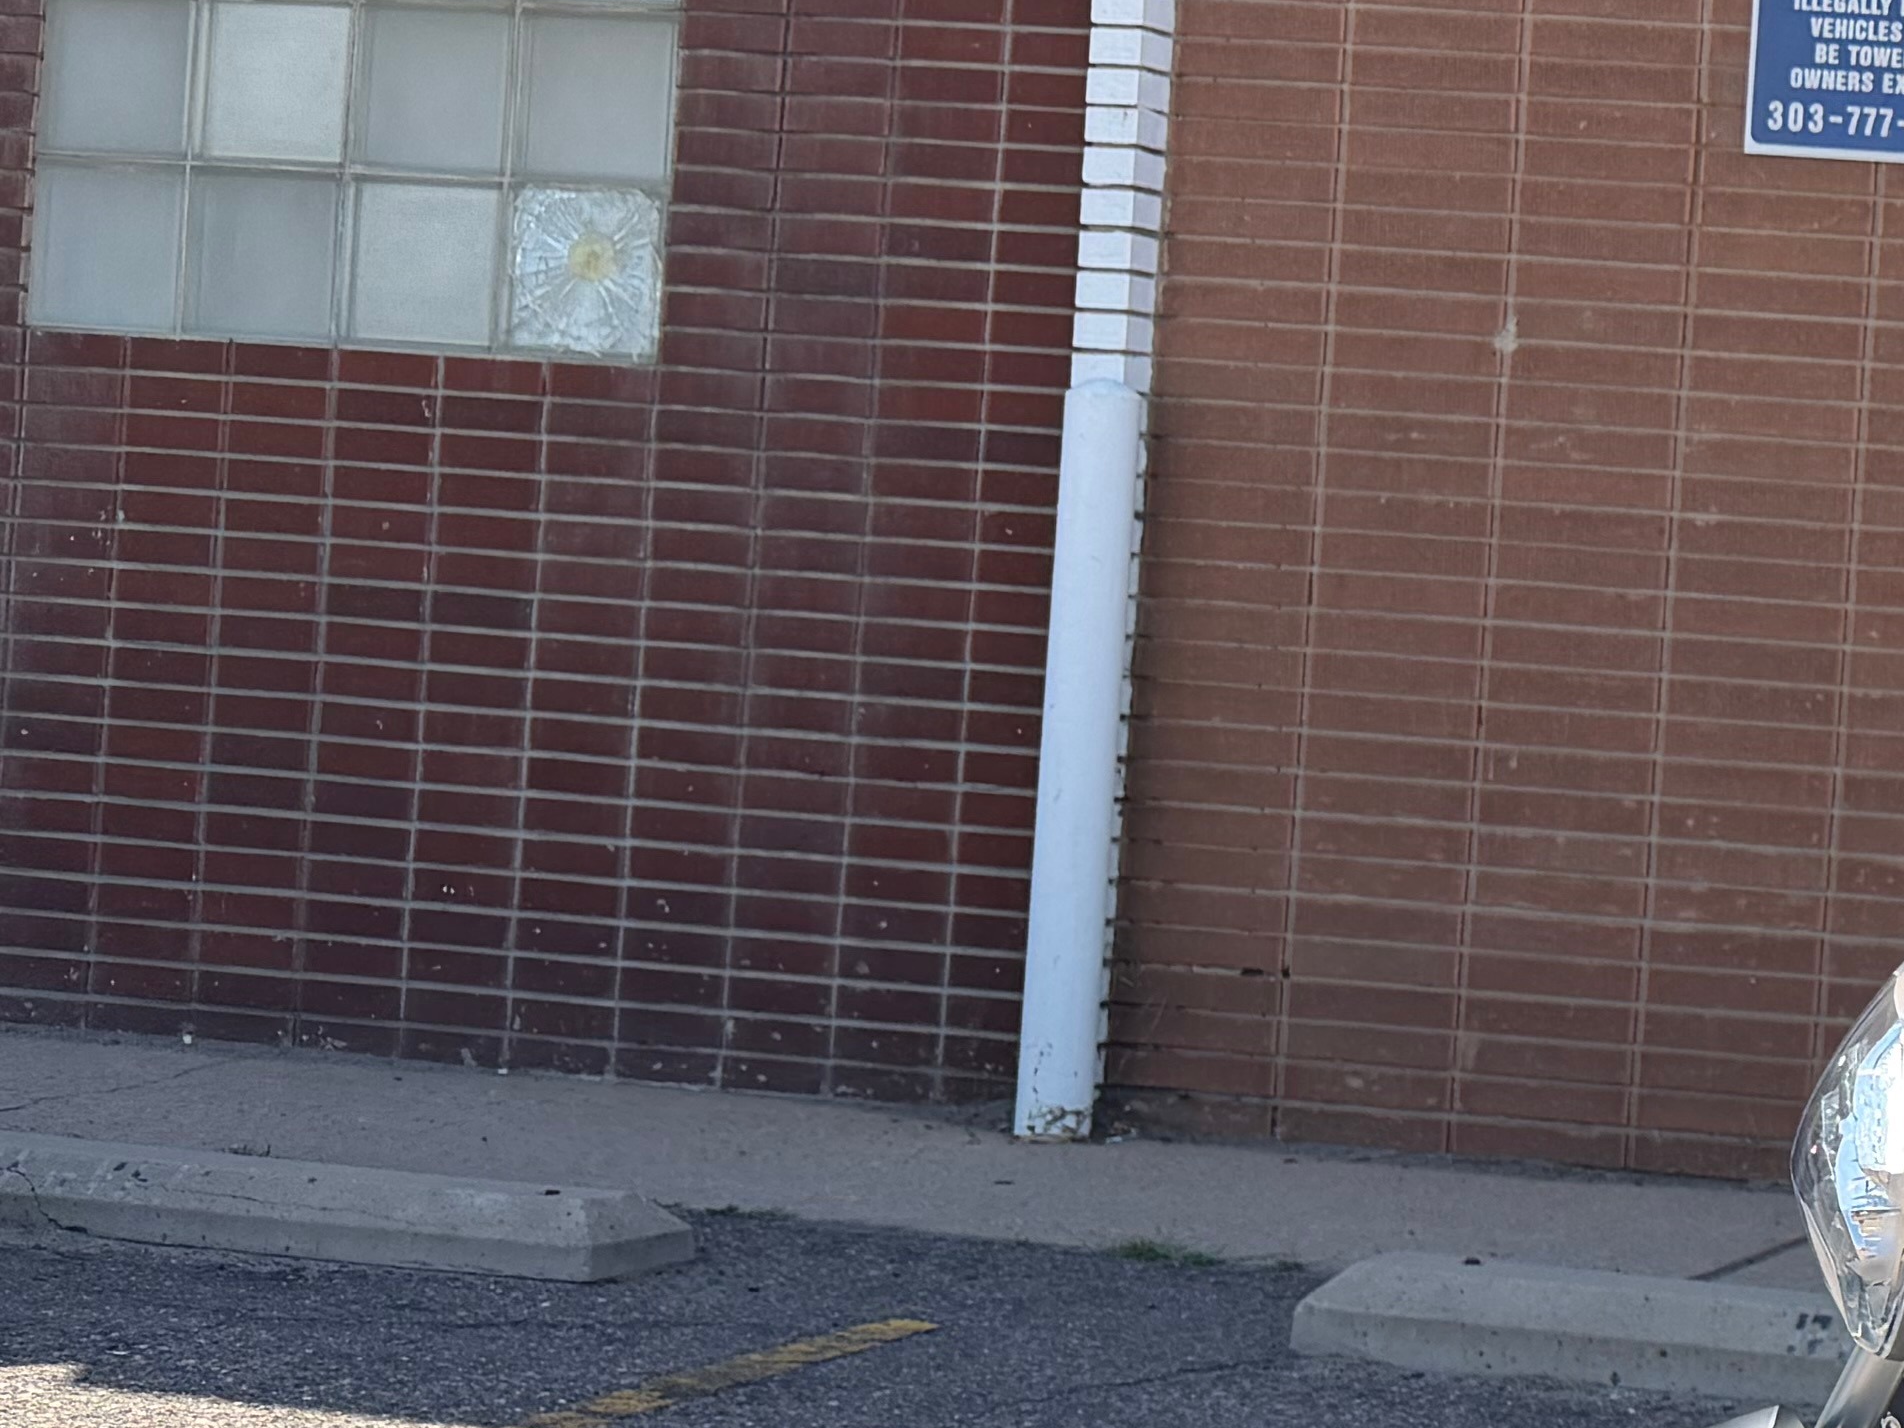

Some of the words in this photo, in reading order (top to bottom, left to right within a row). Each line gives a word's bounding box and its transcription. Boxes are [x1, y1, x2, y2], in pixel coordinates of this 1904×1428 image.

[1811, 17, 1902, 42] VEHICLES
[1815, 44, 1840, 65] BE
[1790, 67, 1874, 93] OWNERS
